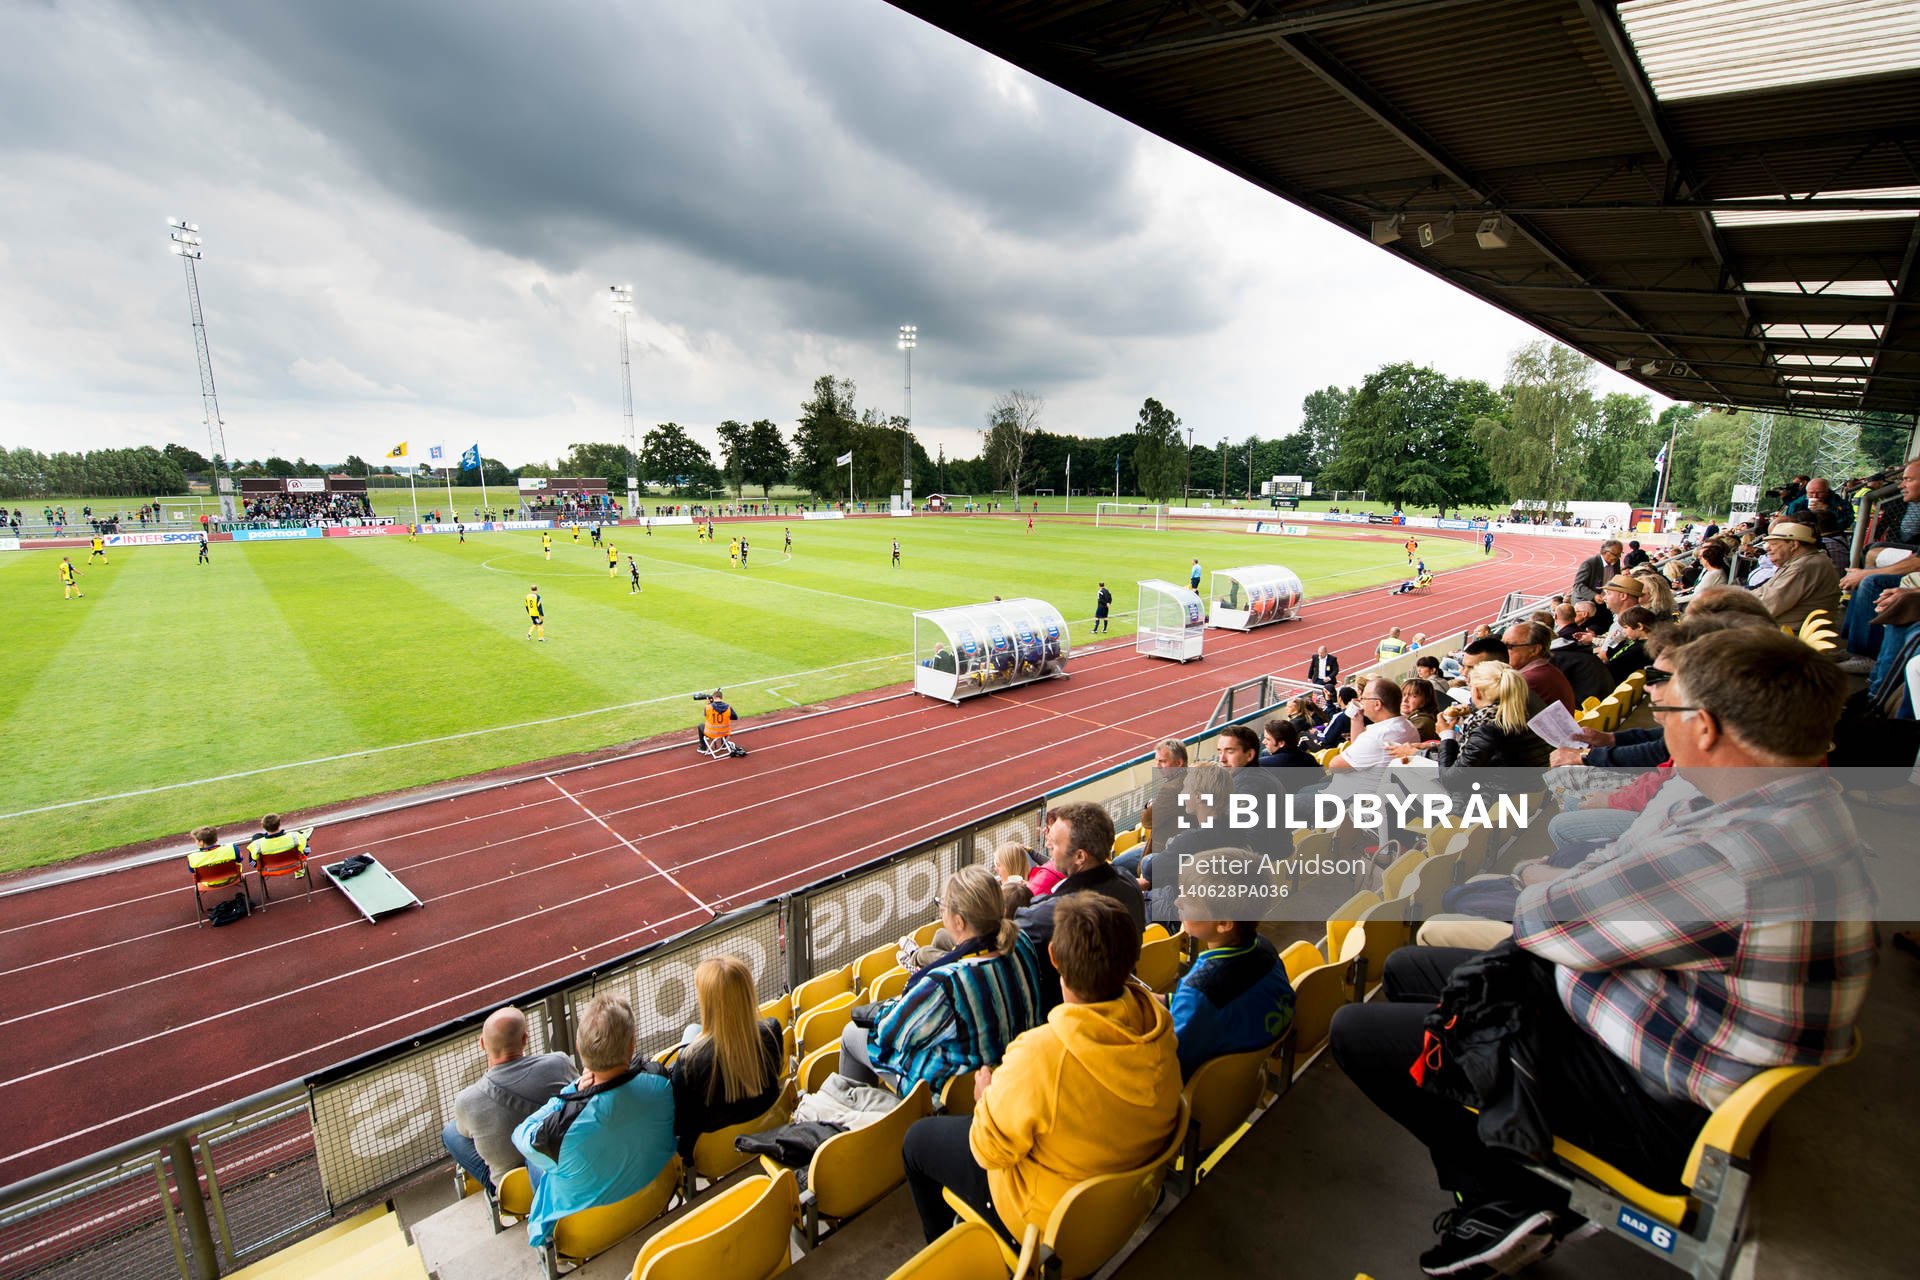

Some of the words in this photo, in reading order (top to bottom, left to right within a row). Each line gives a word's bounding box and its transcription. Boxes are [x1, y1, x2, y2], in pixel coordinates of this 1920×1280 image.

[221, 521, 271, 532] KATEGRI
[348, 527, 388, 535] Scandic
[248, 529, 307, 540] postnord
[712, 713, 723, 723] 10
[1622, 1213, 1648, 1233] RAD
[1651, 1226, 1671, 1248] 6
